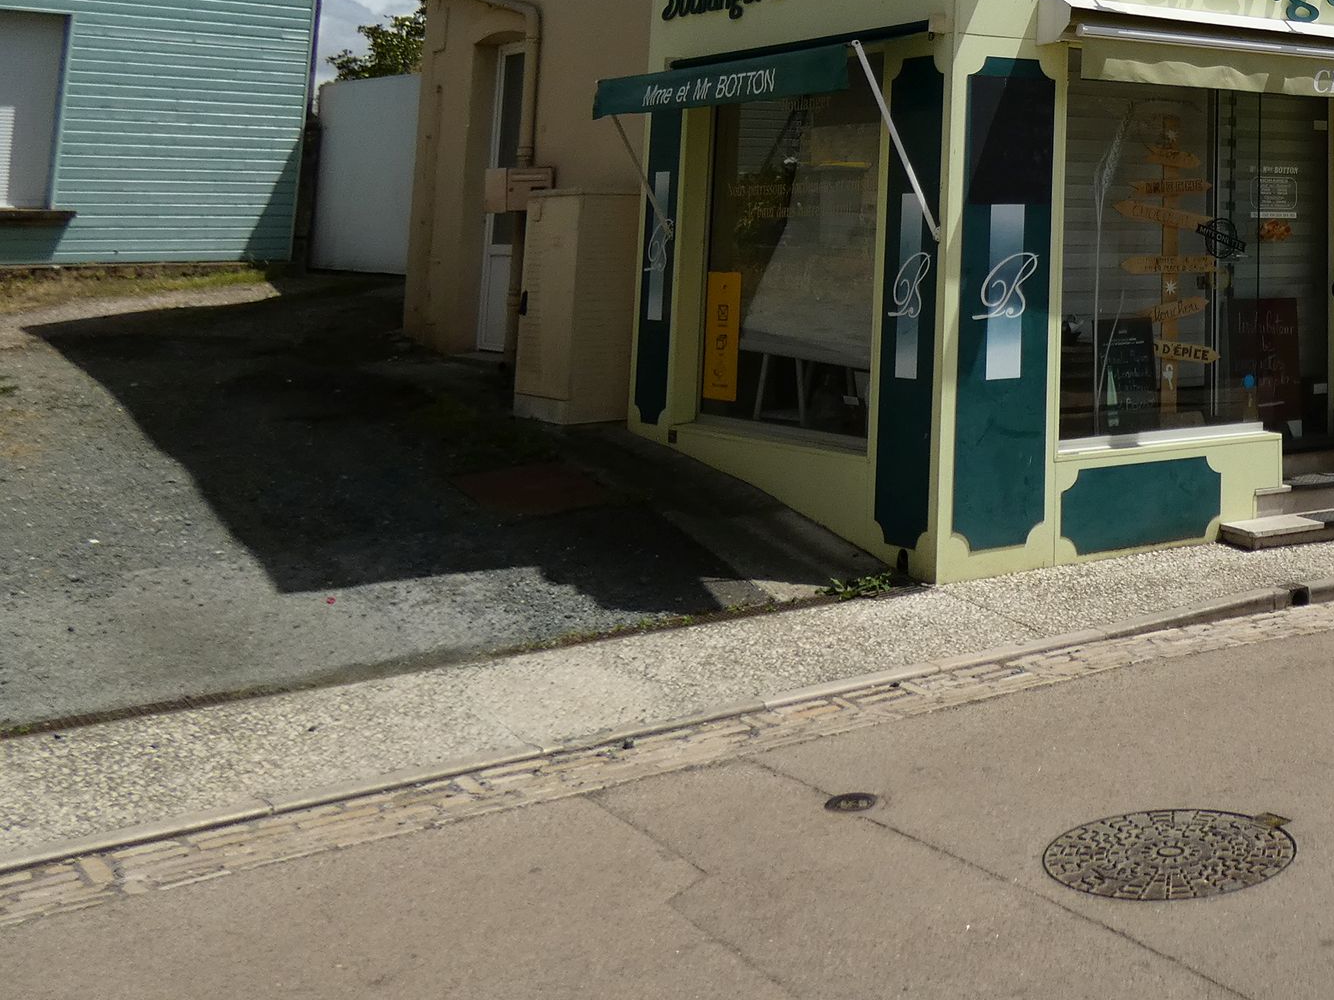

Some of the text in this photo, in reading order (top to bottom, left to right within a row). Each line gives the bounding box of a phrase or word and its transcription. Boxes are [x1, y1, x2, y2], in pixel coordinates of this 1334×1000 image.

[643, 67, 777, 106] Mme et Mr BOTTON
